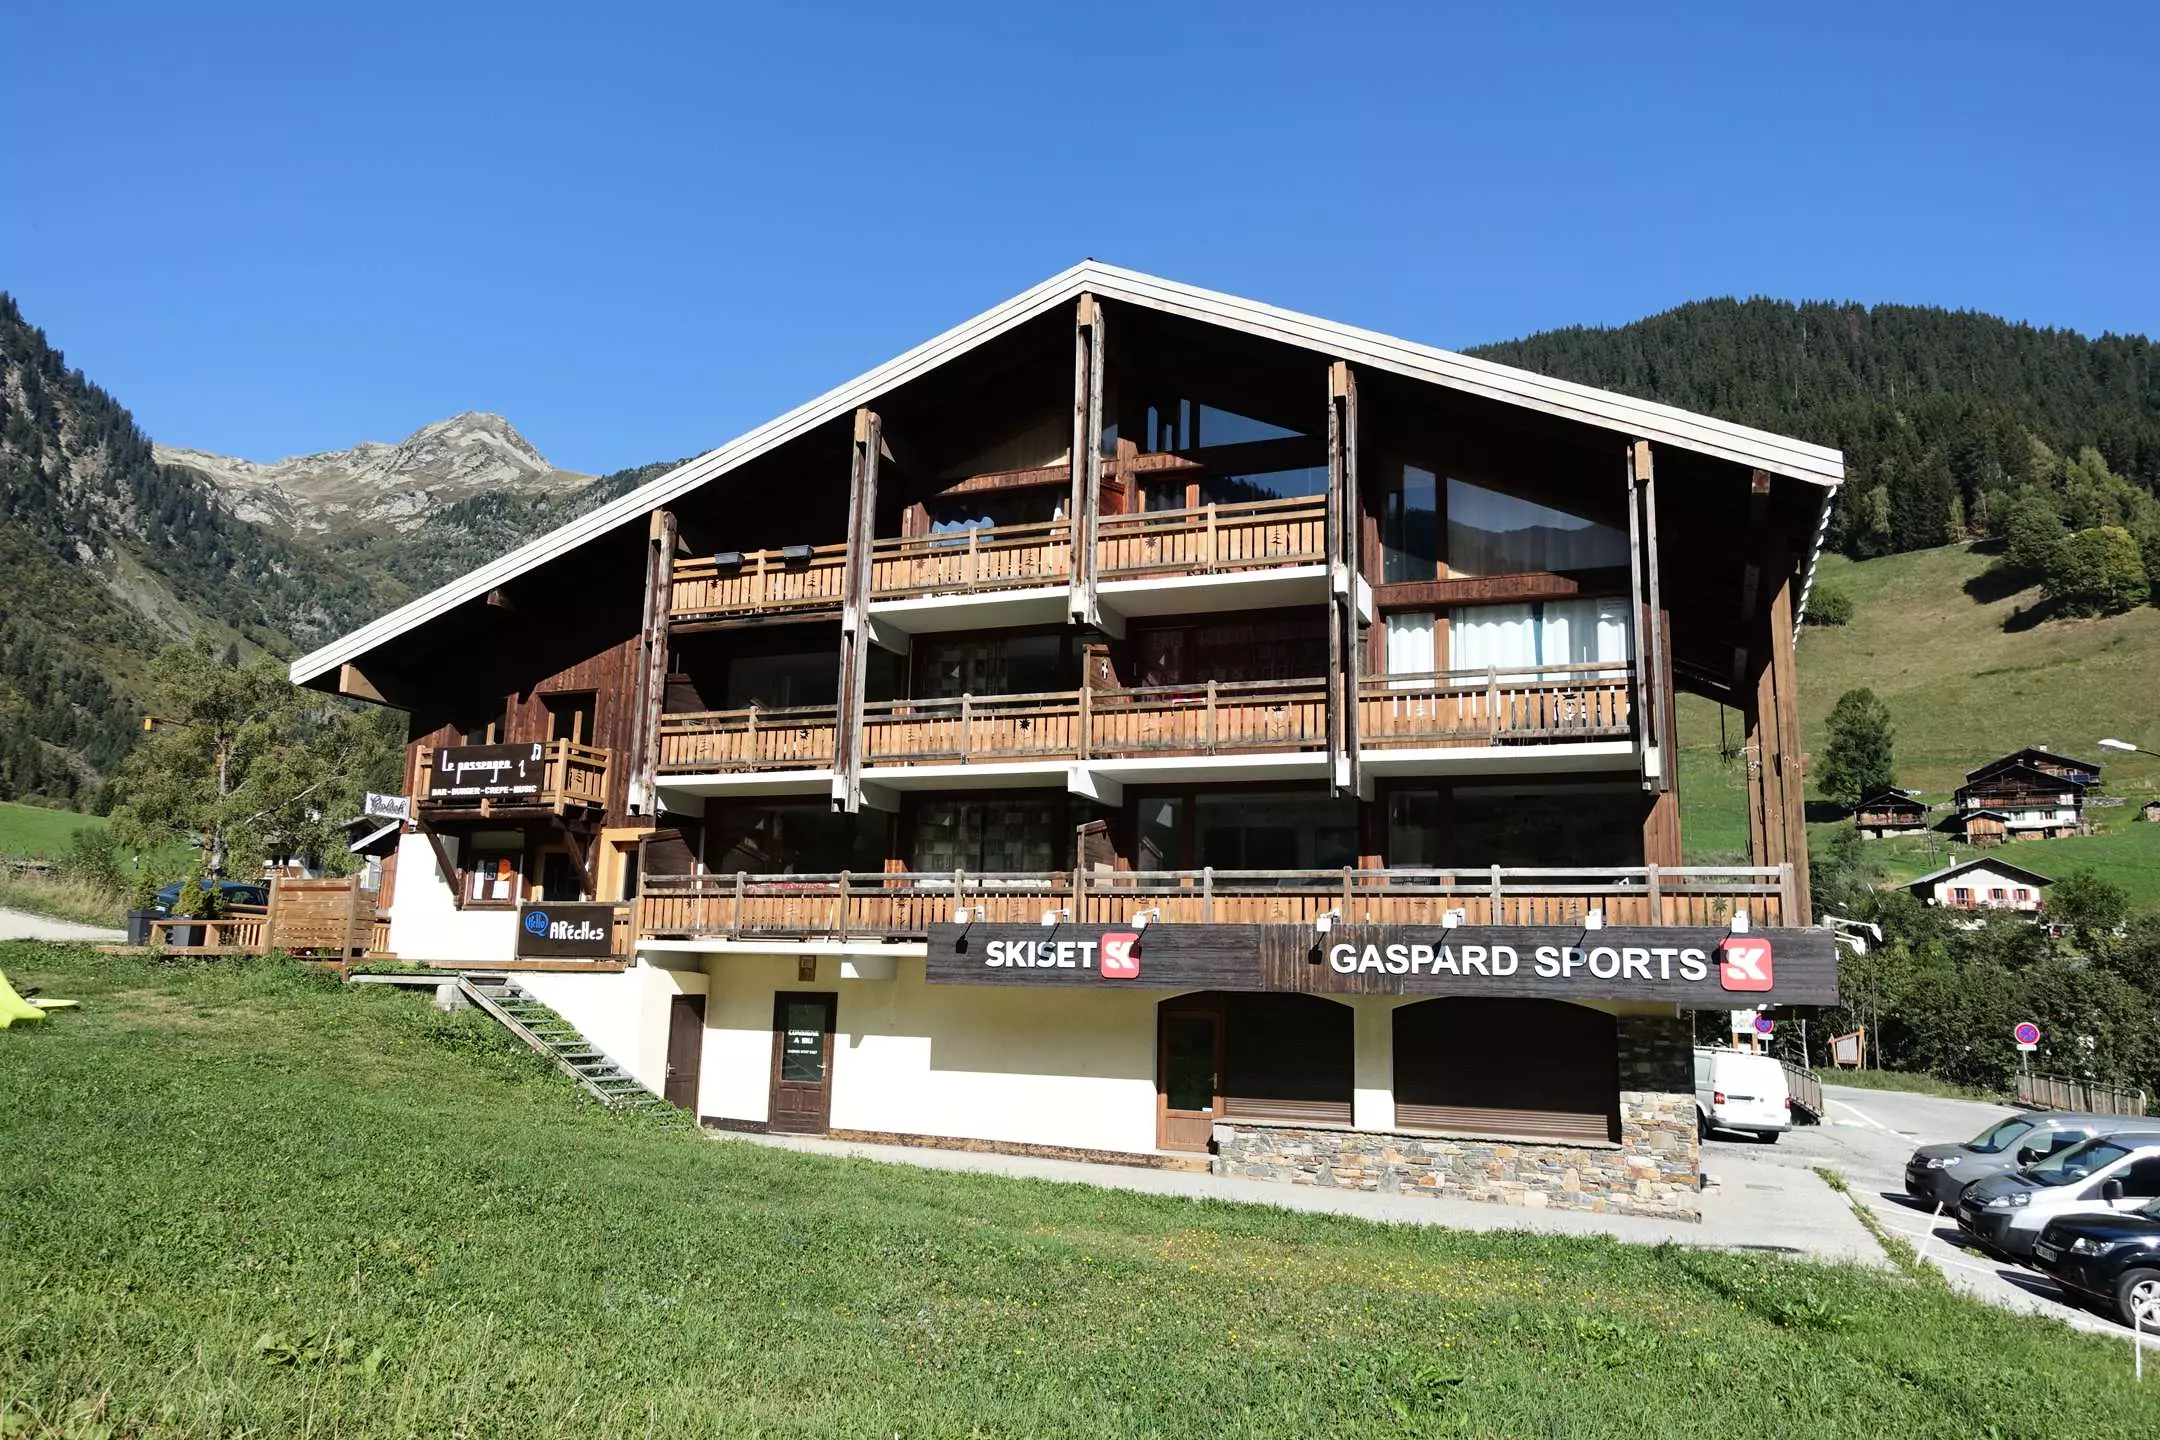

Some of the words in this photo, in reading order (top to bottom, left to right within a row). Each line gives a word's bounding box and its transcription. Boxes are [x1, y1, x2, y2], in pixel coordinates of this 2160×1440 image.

[441, 749, 455, 772] Le
[984, 941, 1098, 968] SKISET
[1329, 944, 1518, 976] GASPARD
[1534, 946, 1708, 981] SPORTS
